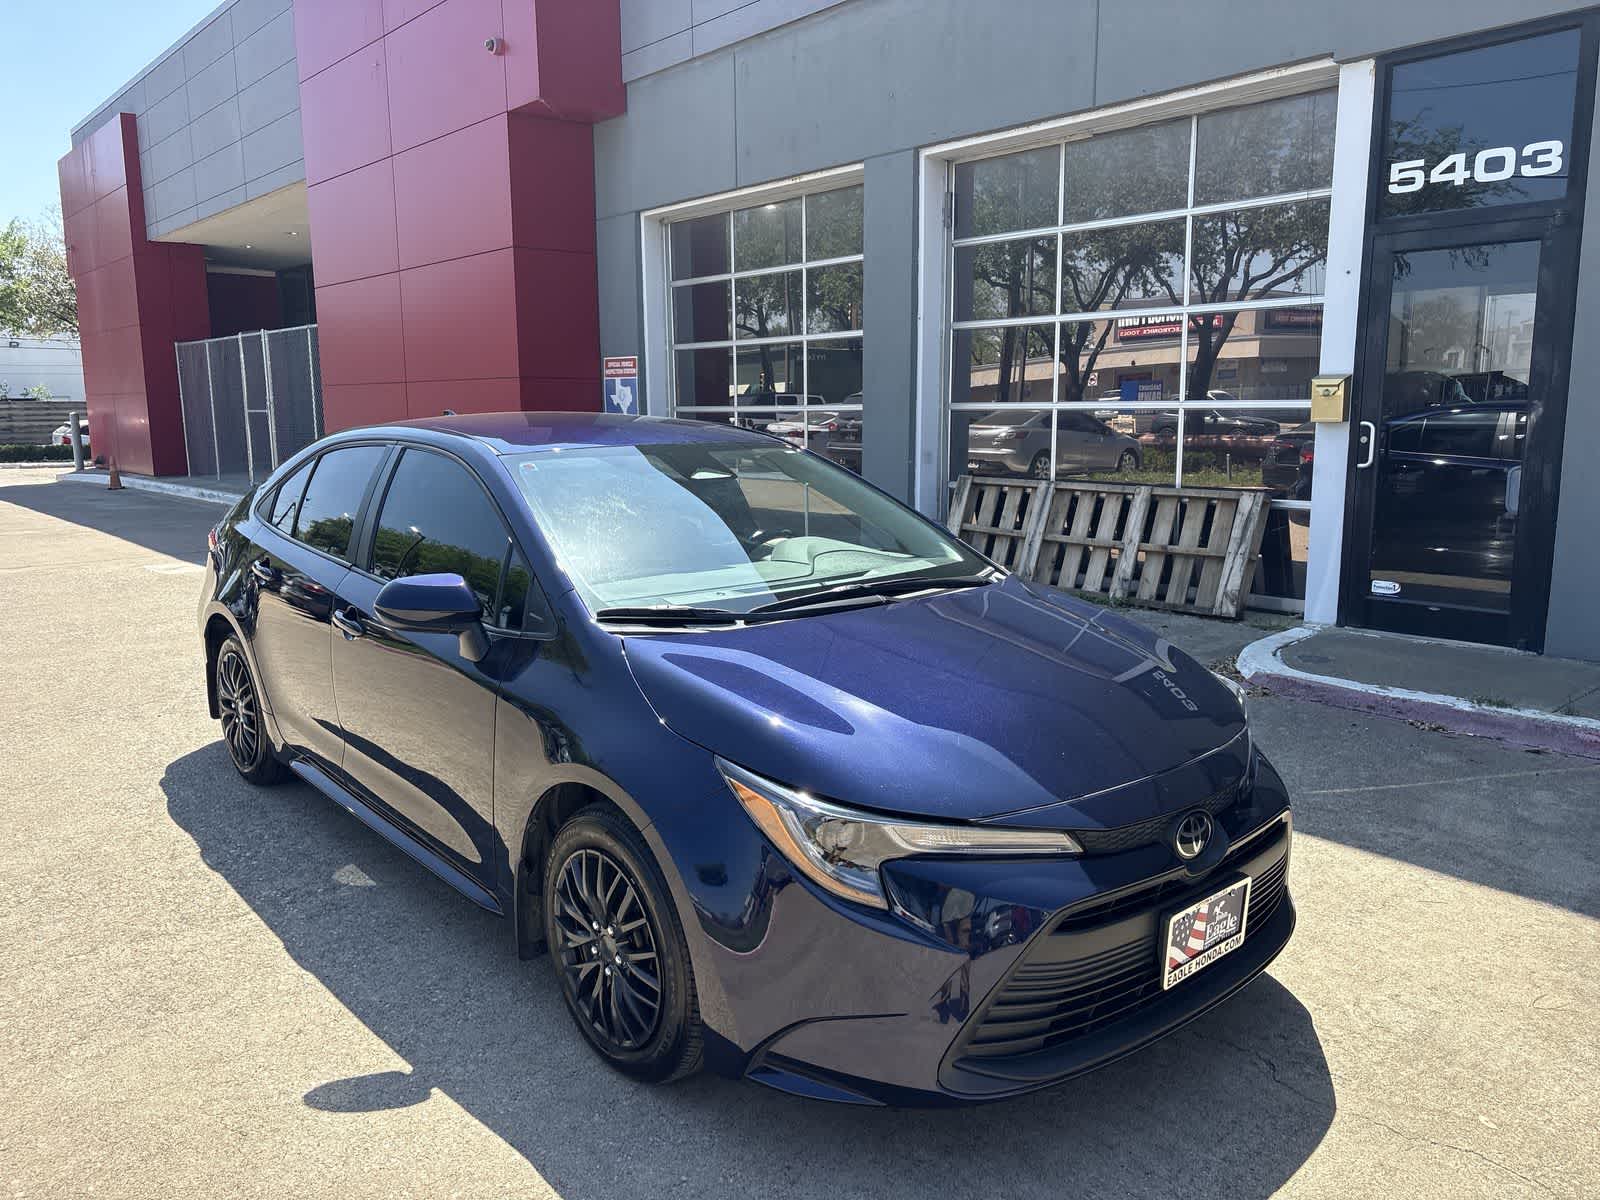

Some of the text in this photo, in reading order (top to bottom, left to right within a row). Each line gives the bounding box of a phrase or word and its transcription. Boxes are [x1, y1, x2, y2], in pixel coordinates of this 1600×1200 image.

[1388, 140, 1563, 194] 5403
[1206, 914, 1238, 940] Eagle
[1194, 934, 1242, 969] HONDA.COM
